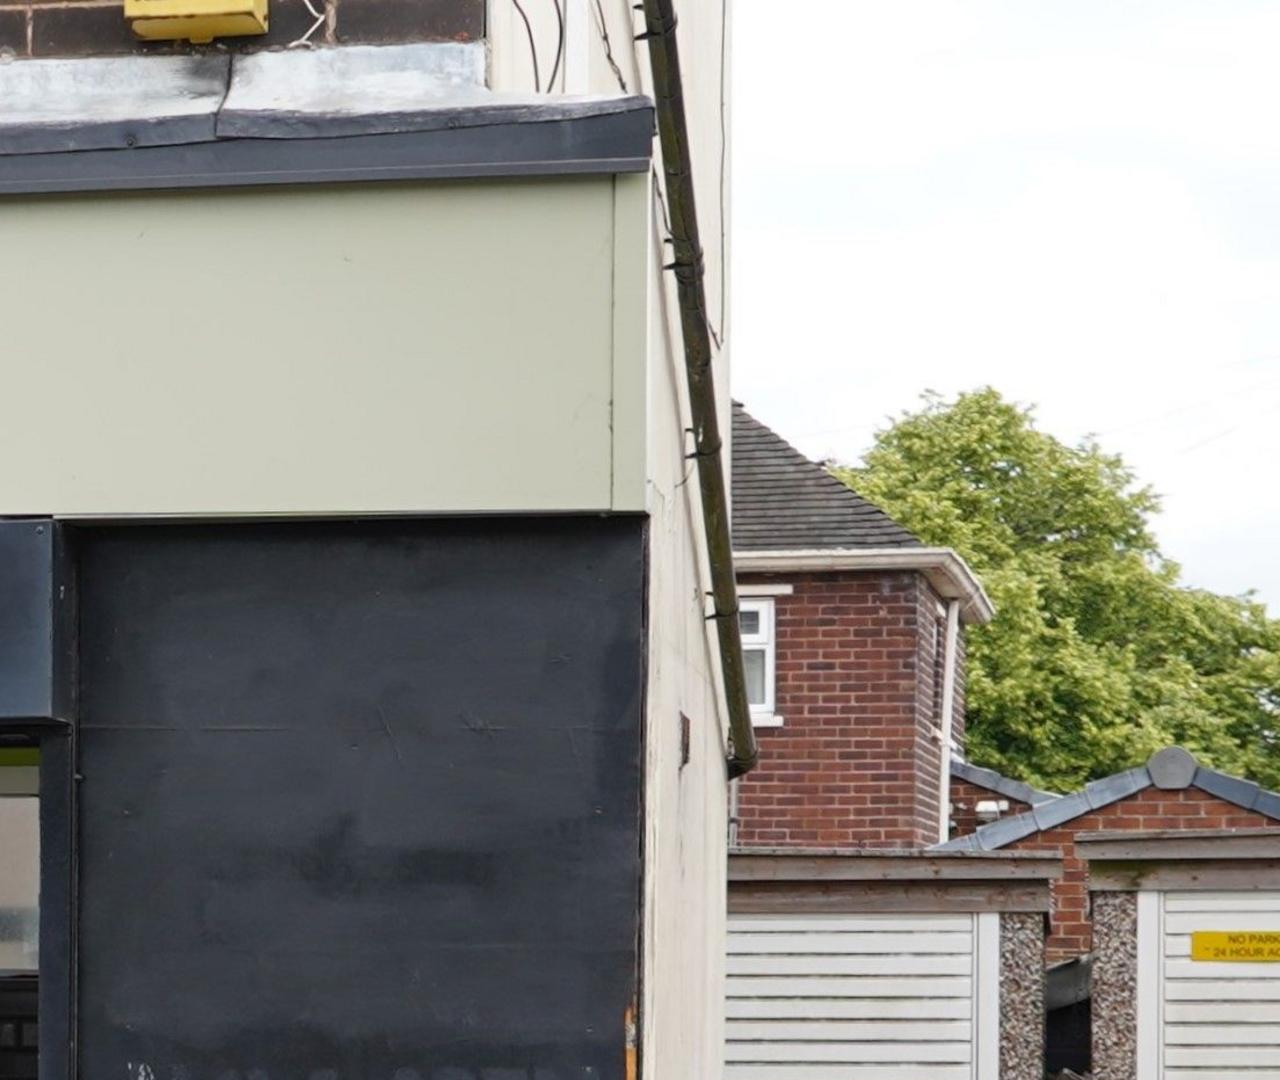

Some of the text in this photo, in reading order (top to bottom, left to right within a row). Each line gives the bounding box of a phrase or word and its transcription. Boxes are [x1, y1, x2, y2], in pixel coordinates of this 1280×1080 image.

[1228, 934, 1246, 944] NO
[1213, 947, 1226, 957] 24
[1229, 947, 1264, 957] HOUR
